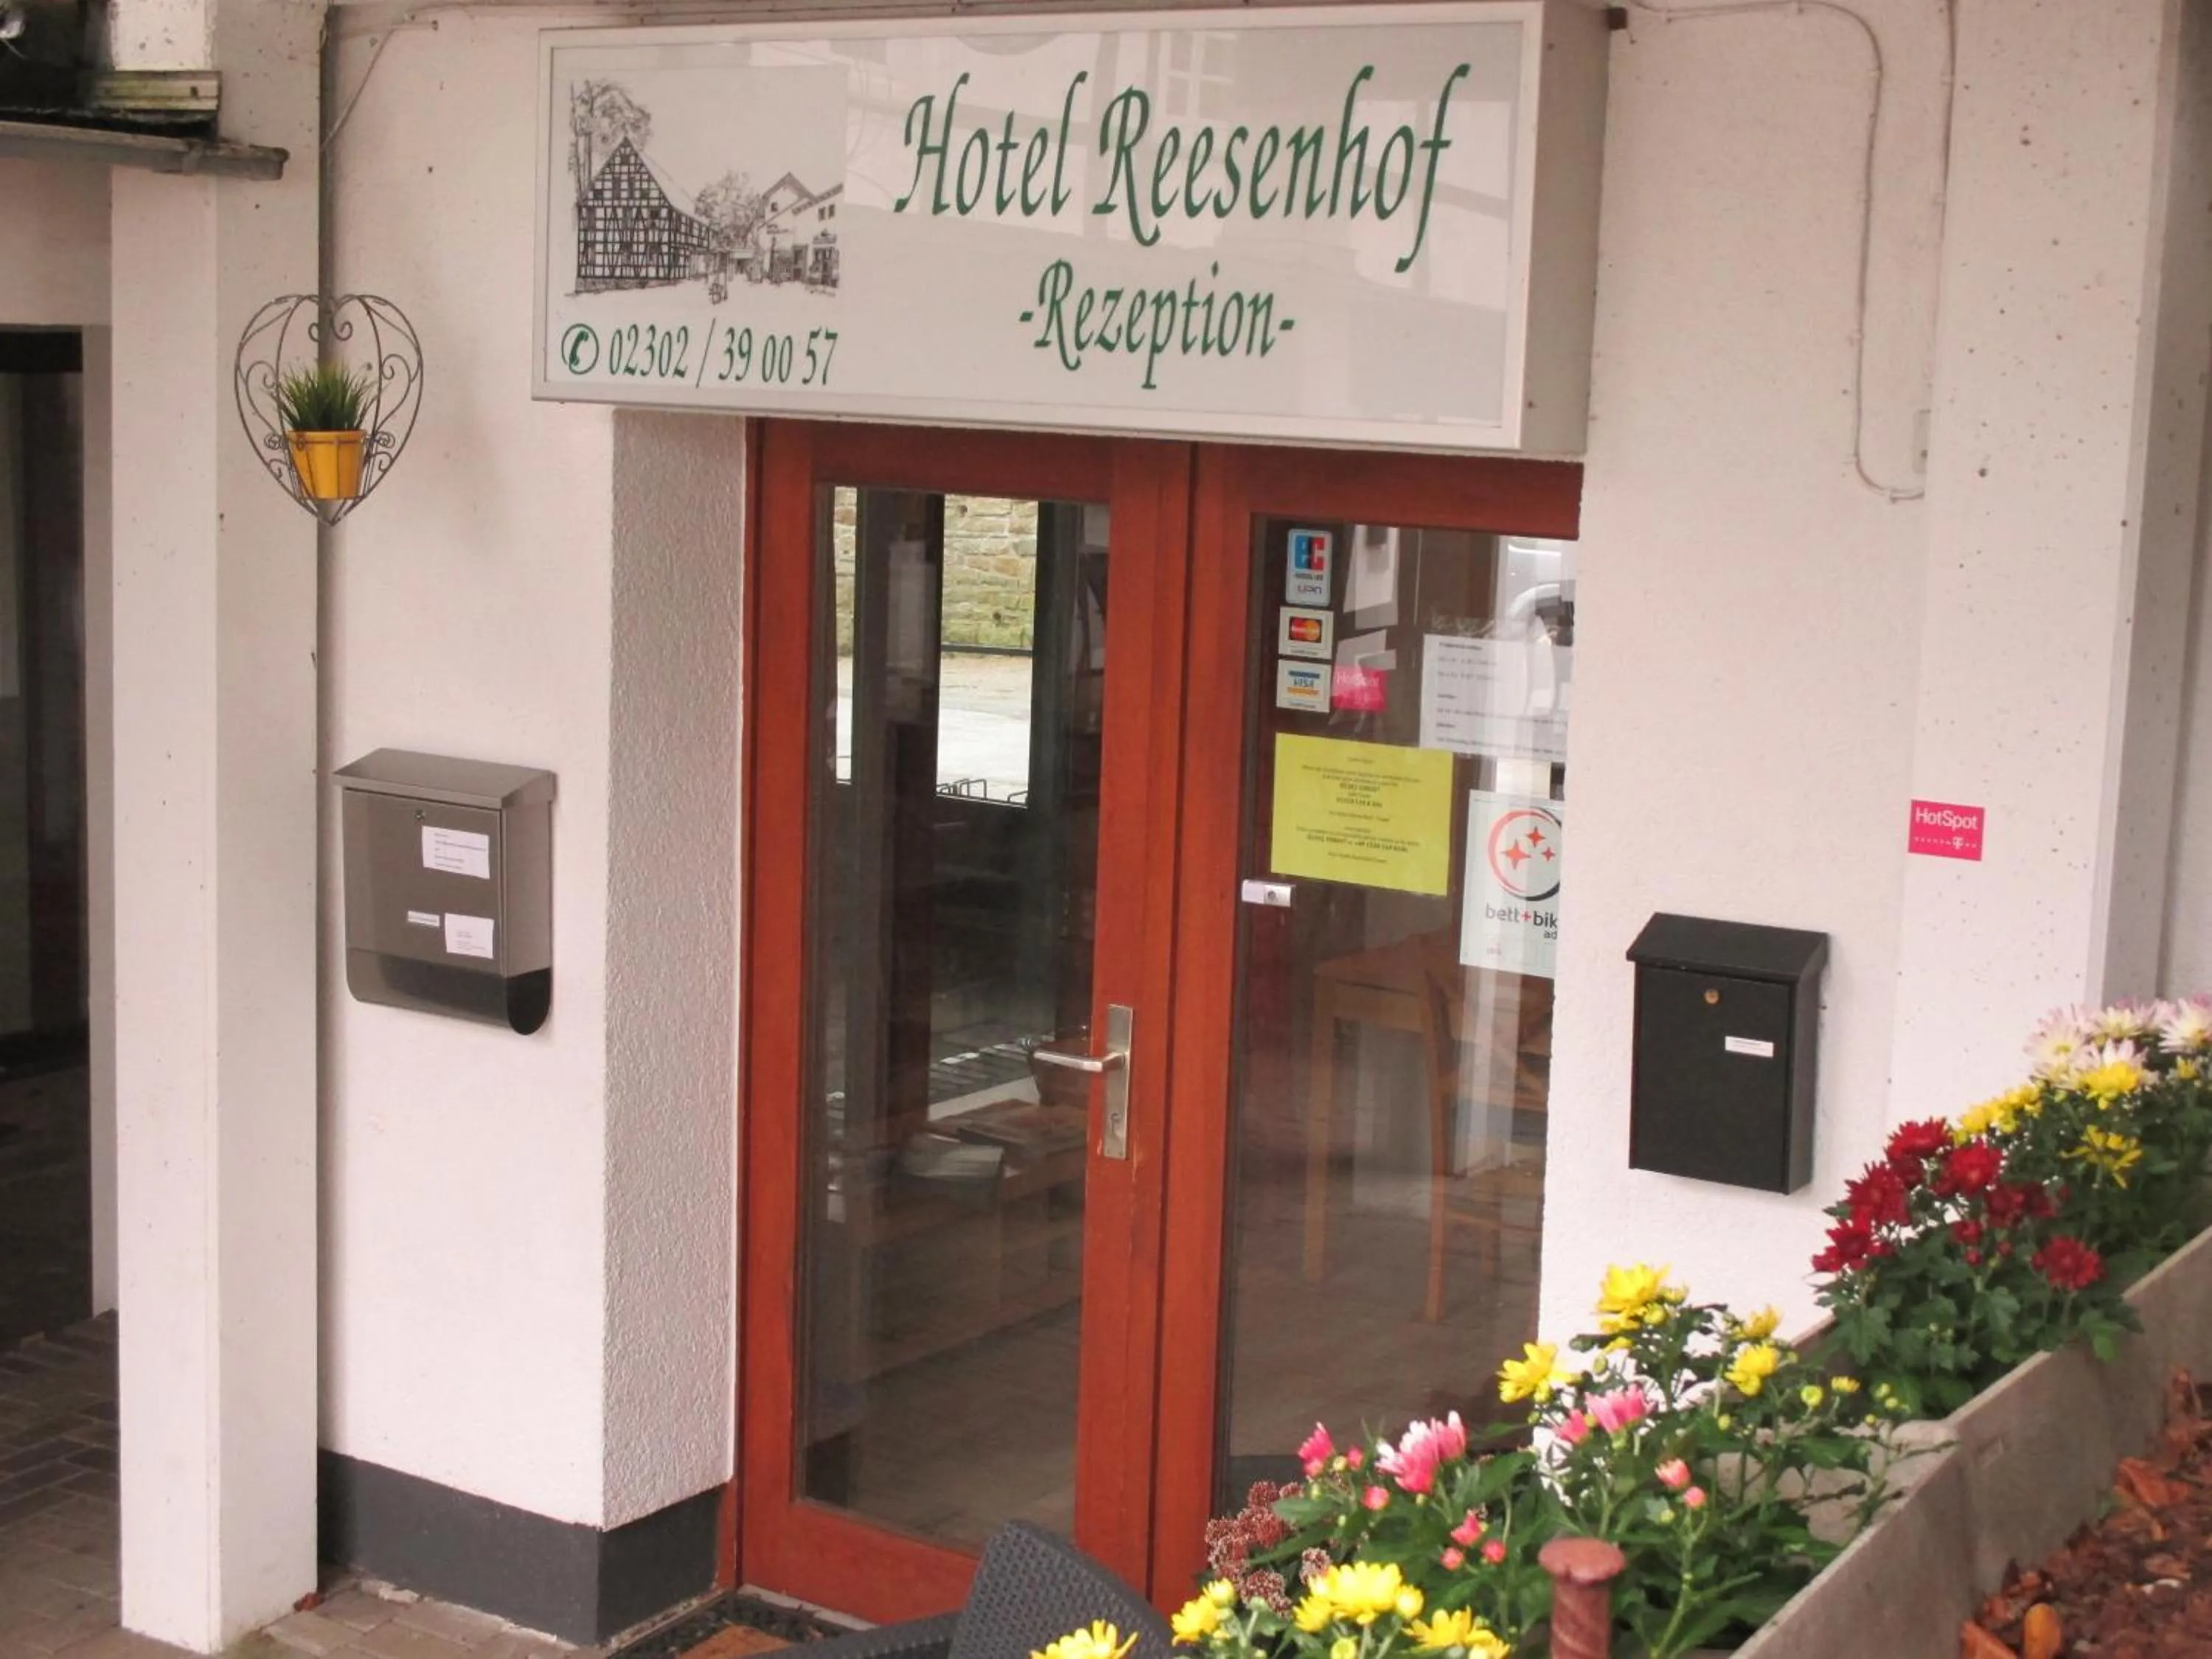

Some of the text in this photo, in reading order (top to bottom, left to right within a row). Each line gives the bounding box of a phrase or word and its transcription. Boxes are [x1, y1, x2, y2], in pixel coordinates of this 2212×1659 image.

[894, 63, 1470, 274] Hotel Reesenhof
[609, 324, 689, 378] 02302
[718, 327, 752, 382] 39
[762, 334, 793, 384] 00
[802, 325, 838, 386] 57
[1019, 259, 1295, 389] -Rezeption-
[1915, 806, 1979, 832] HotSpot
[1485, 902, 1558, 929] bett+bik
